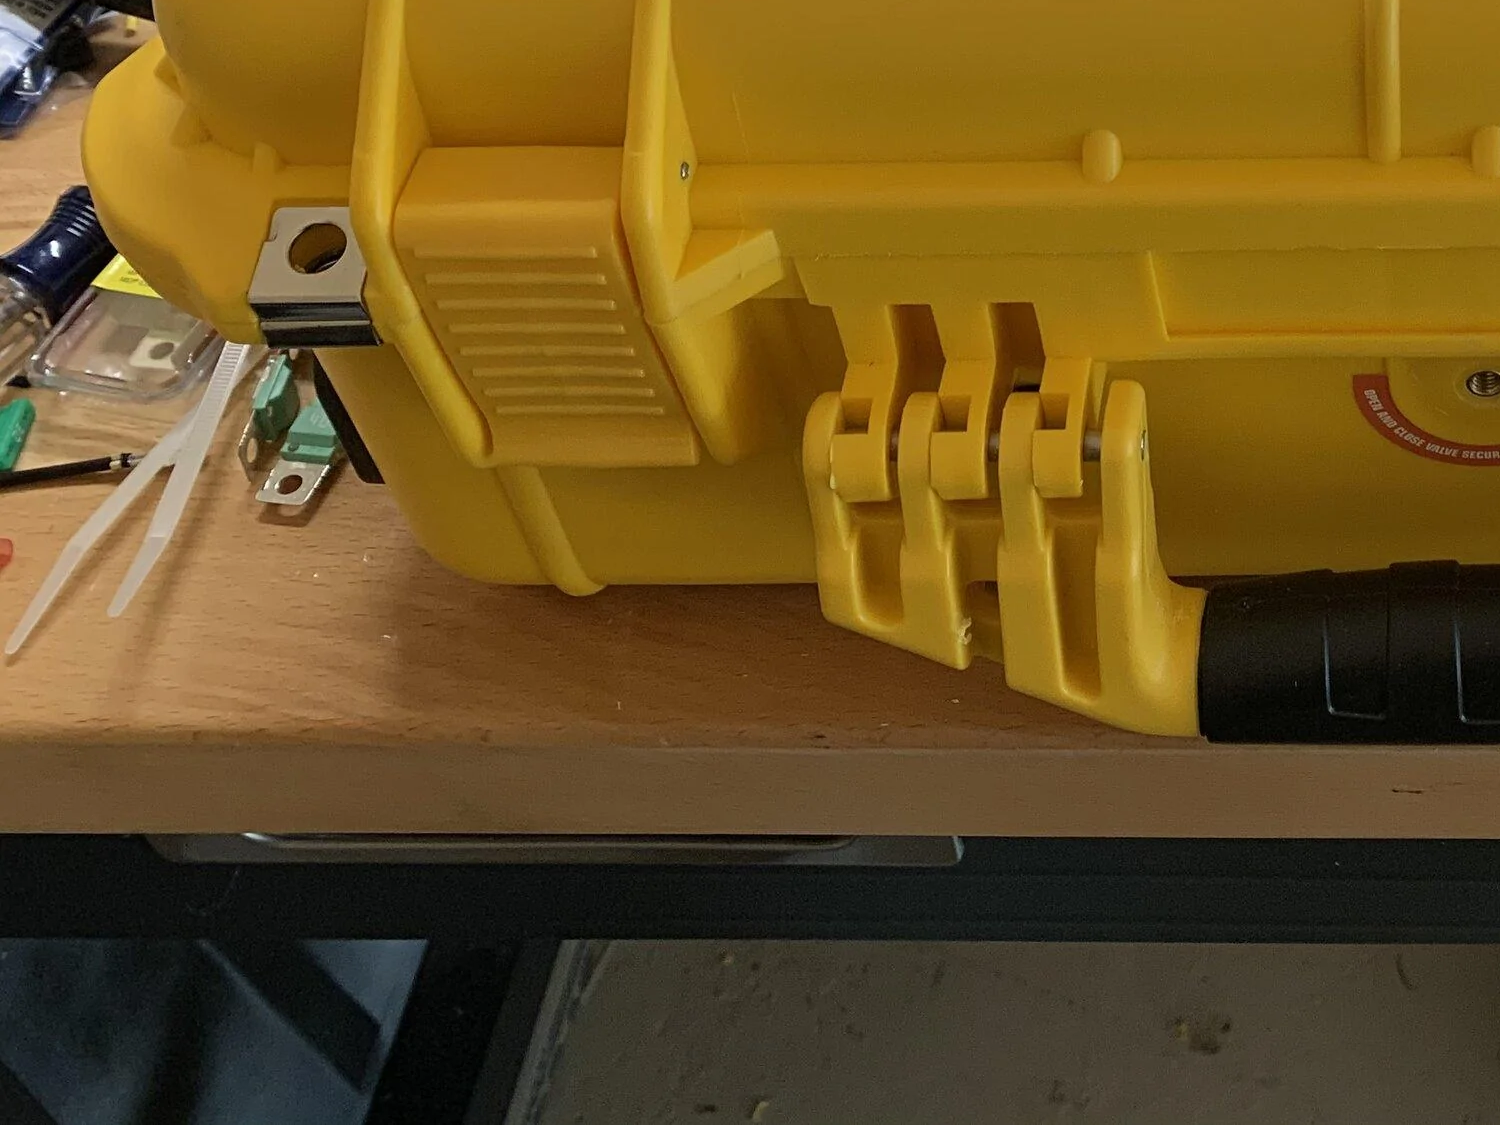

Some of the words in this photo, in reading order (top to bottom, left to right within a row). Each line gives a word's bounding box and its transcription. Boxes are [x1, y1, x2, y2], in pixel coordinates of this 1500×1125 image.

[1364, 388, 1384, 412] OPEN
[1377, 411, 1398, 429] AND
[1394, 426, 1426, 447] CLOSE
[1425, 442, 1459, 457] VALVE
